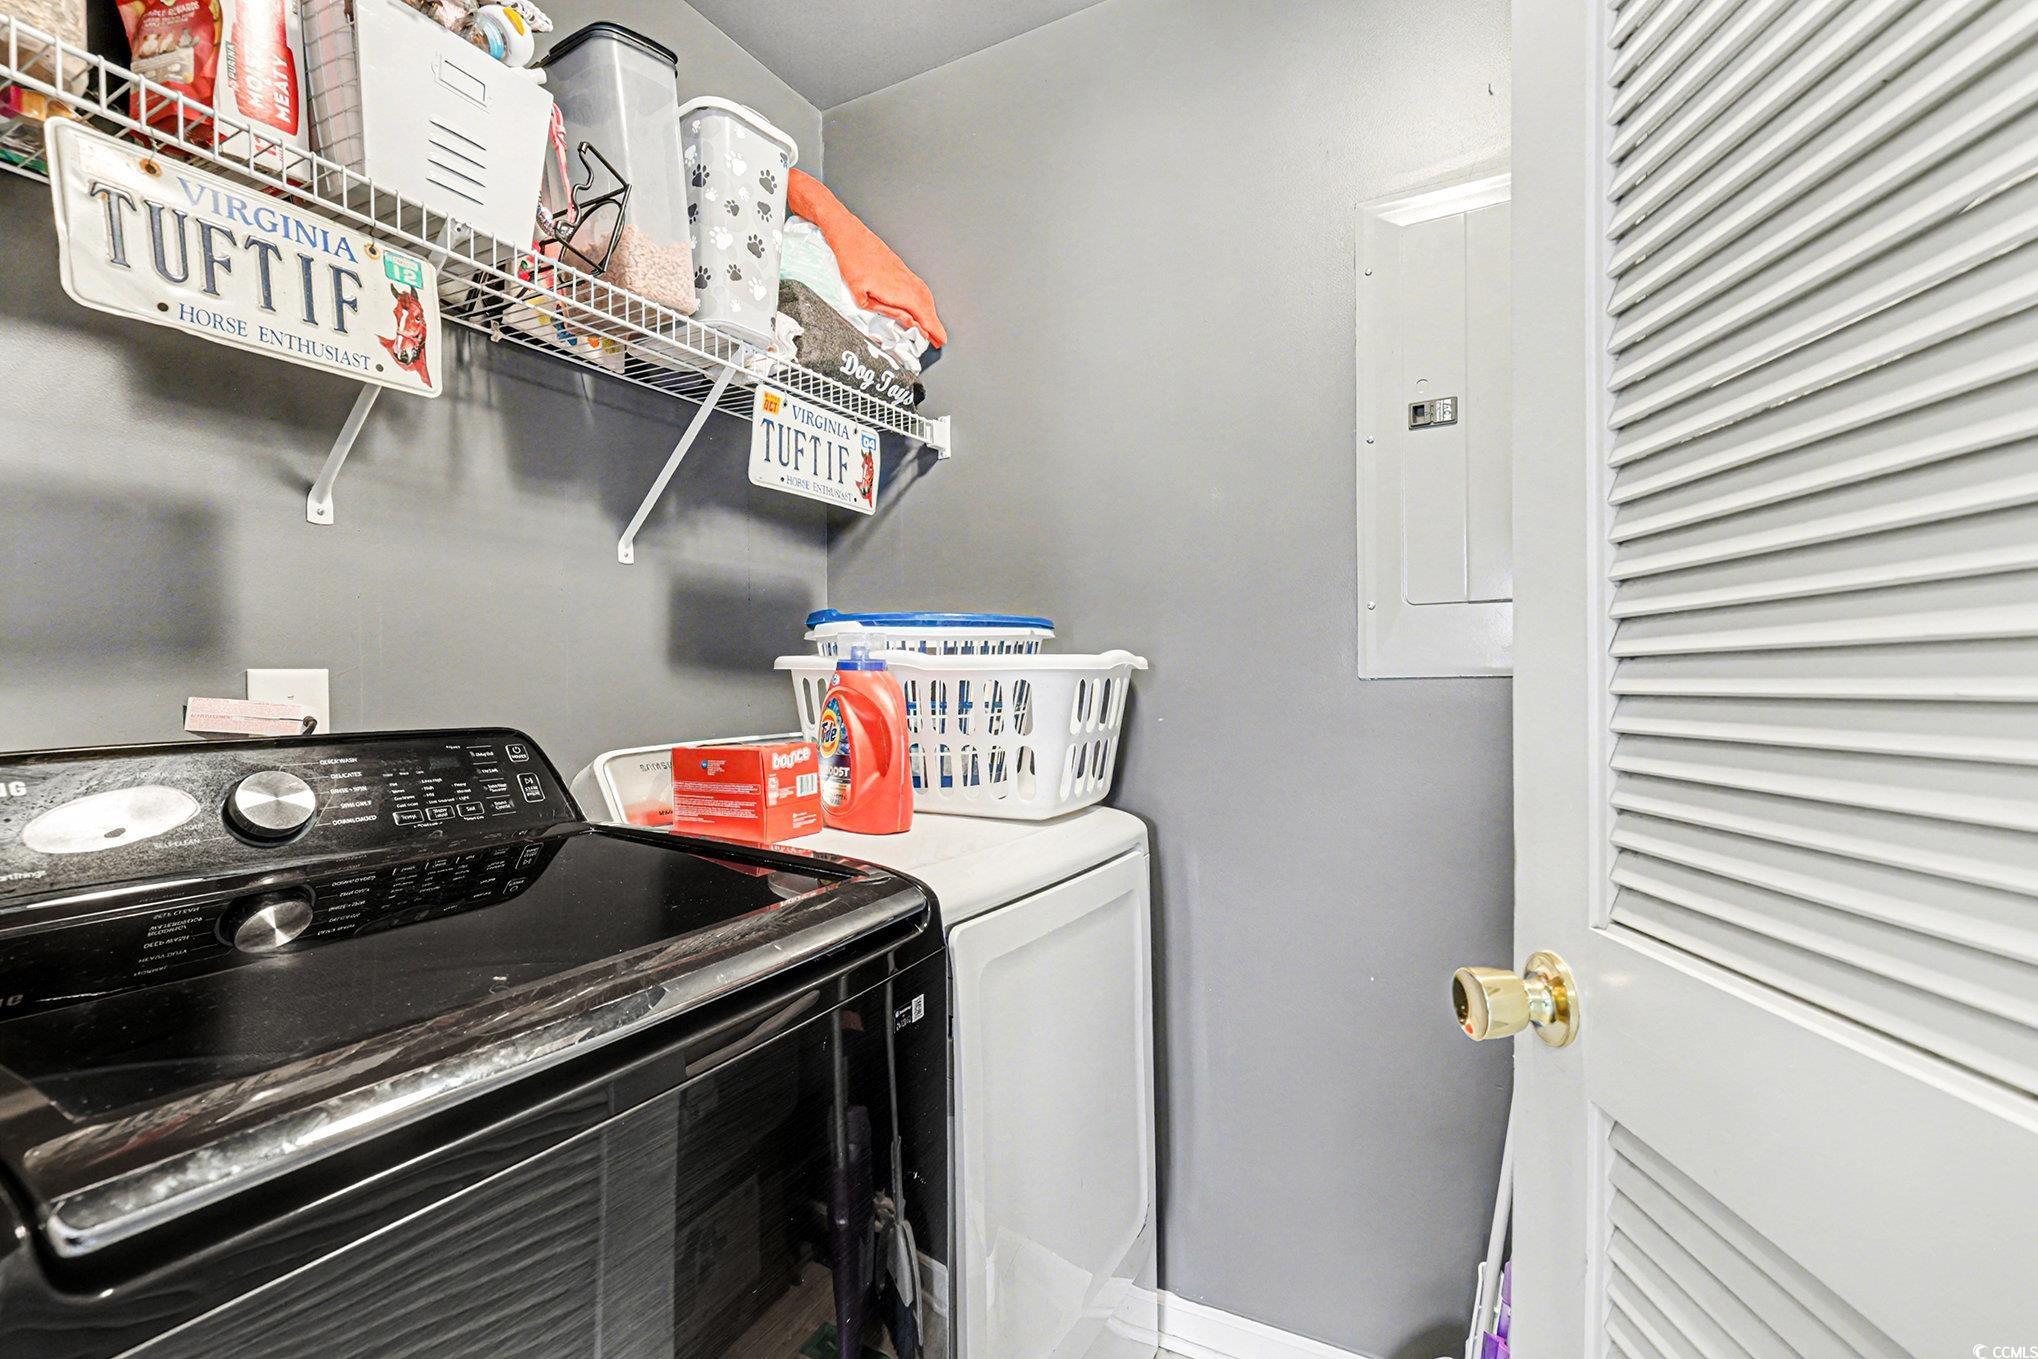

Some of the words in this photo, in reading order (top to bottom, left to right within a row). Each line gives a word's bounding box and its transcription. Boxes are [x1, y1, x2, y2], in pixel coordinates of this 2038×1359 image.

[227, 43, 237, 79] PURINA
[271, 54, 291, 124] MEATY
[177, 177, 359, 264] VIRGINIA
[90, 181, 363, 334] TUFTIF
[392, 263, 418, 286] 12
[178, 303, 248, 338] HORSE
[258, 325, 371, 371] ENTHUSIAST
[840, 350, 876, 390] Dog
[876, 370, 914, 407] Toys
[760, 418, 850, 485] TUFTIF
[792, 405, 850, 440] VIRGINIA
[772, 746, 812, 771] bounce
